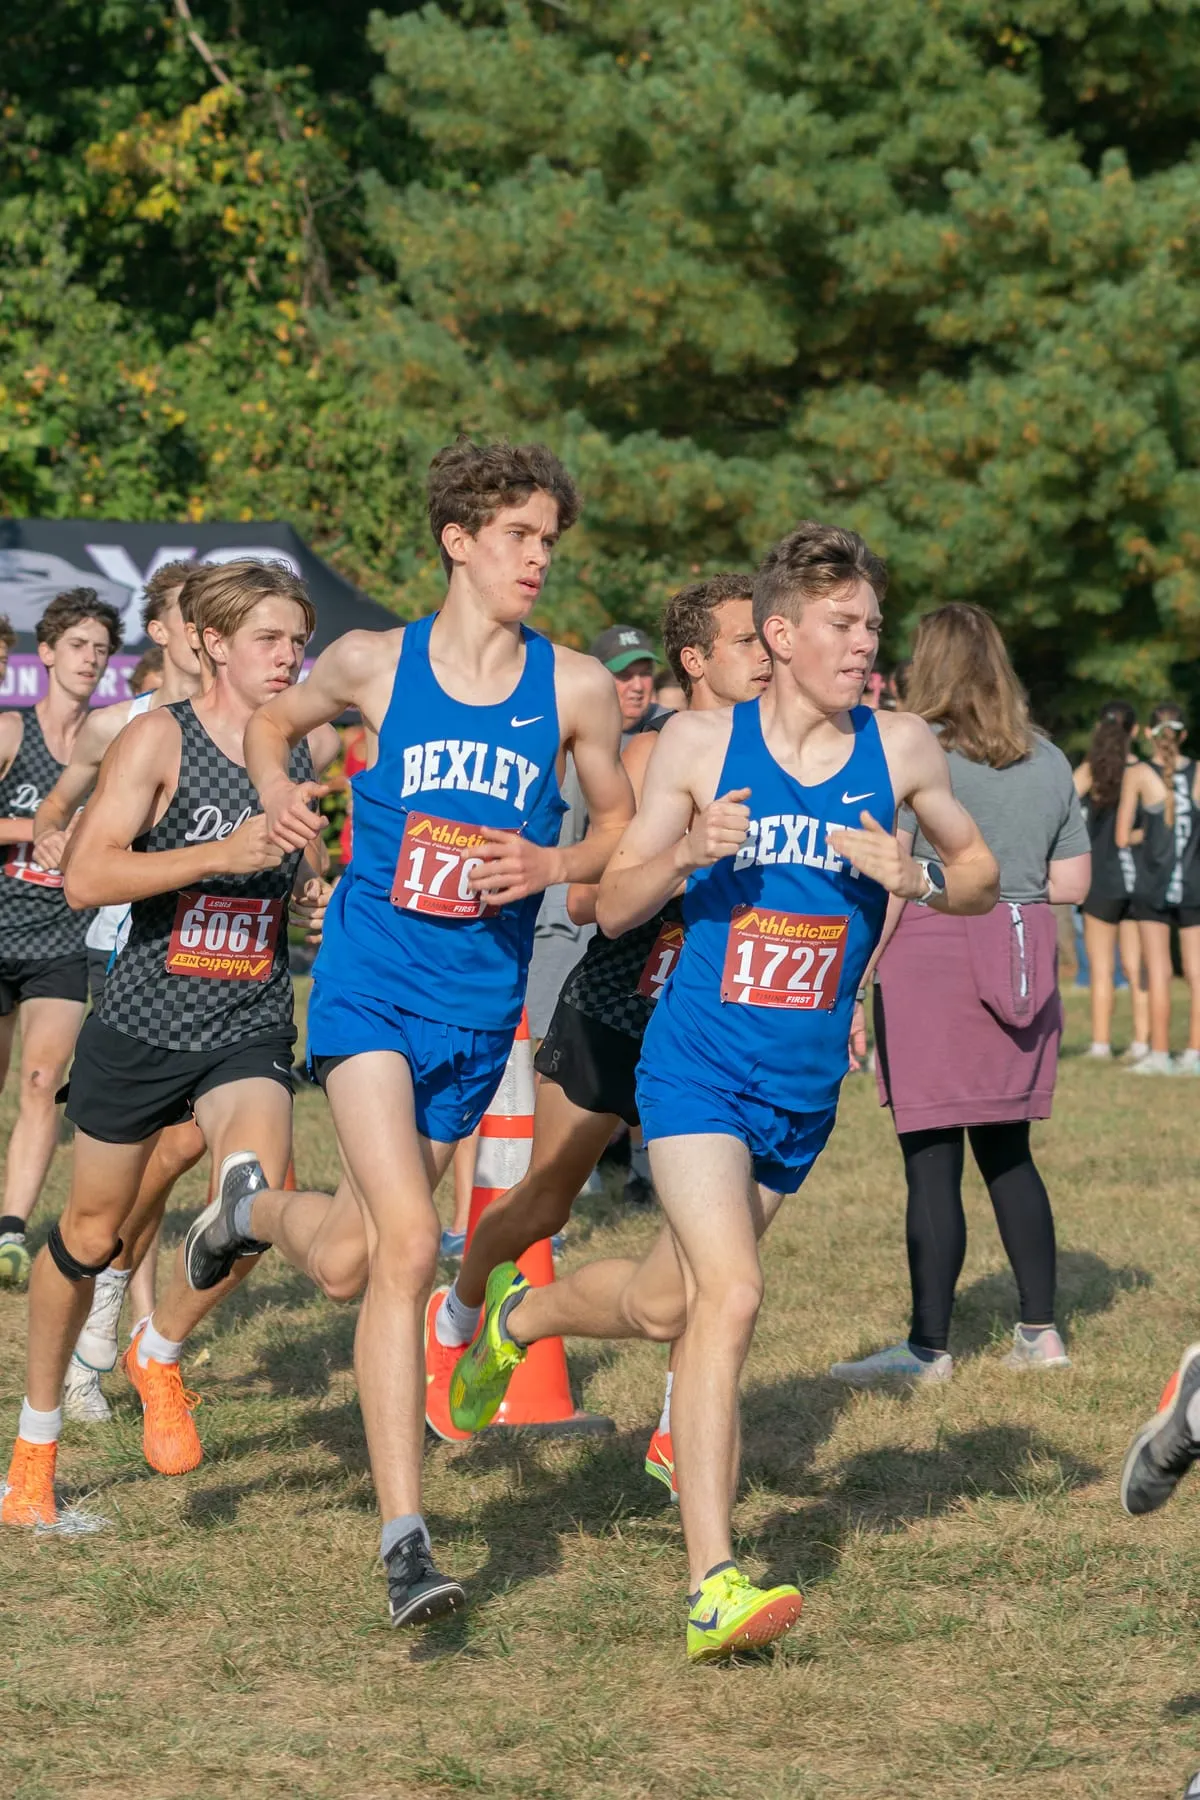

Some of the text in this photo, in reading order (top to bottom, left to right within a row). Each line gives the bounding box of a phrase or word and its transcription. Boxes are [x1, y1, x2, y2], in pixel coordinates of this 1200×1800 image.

[401, 739, 540, 812] BEXLEY
[208, 900, 232, 908] FIRST
[453, 905, 477, 913] FIRST
[180, 908, 274, 952] 1909
[733, 940, 837, 991] 1727
[785, 994, 812, 1004] FIRST
